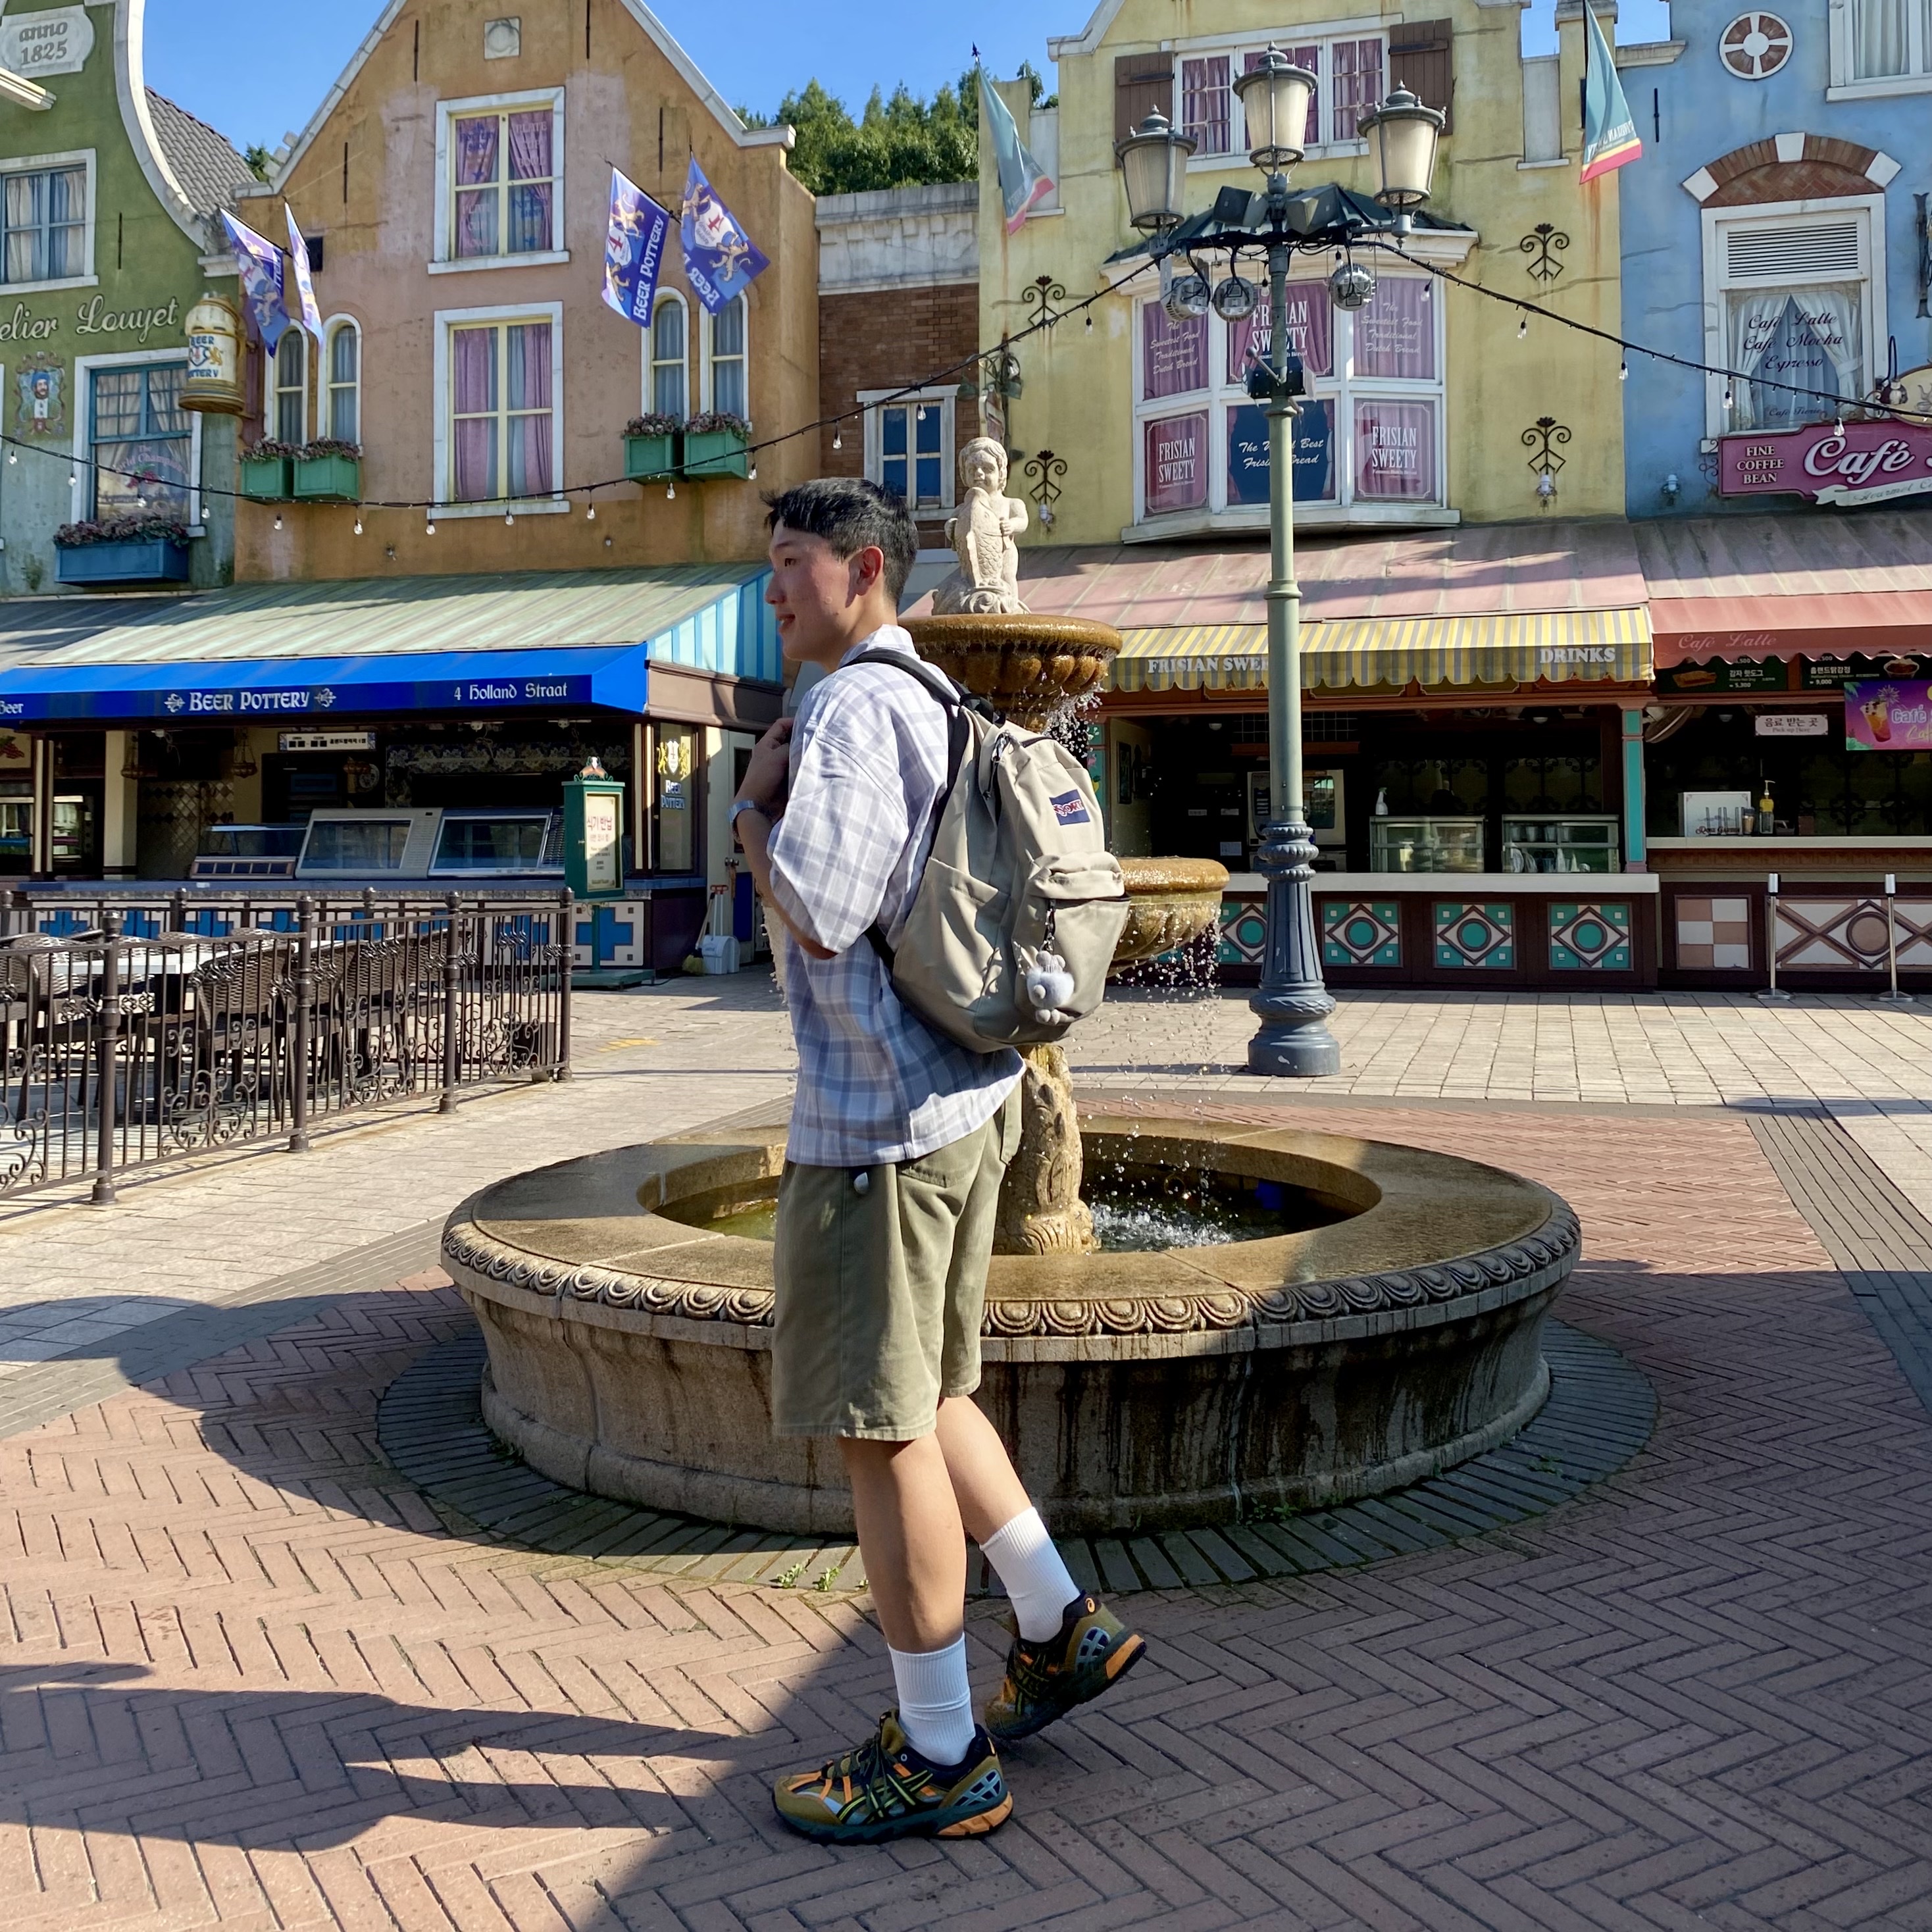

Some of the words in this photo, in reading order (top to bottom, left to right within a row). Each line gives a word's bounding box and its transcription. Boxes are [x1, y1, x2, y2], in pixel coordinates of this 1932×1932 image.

[19, 22, 68, 42] anno
[20, 38, 68, 65] 1825
[608, 236, 623, 253] 4
[640, 215, 664, 278] POTTERY
[634, 280, 651, 321] BEER
[1383, 303, 1399, 311] The
[76, 294, 180, 343] Louyet
[1361, 316, 1398, 325] Sweetest
[1402, 317, 1423, 327] Food
[1182, 330, 1200, 342] Food
[1369, 330, 1417, 340] Traditional
[1787, 333, 1843, 347] Mocha
[1156, 344, 1195, 360] Traditional
[1365, 343, 1391, 352] Dutch
[1395, 344, 1421, 353] Bread
[1153, 362, 1173, 374] Dutch
[1177, 357, 1198, 369] Bread
[1765, 355, 1823, 372] Espresso
[1372, 426, 1417, 447] FRISIAN
[1159, 438, 1196, 462] FRISIAN
[1238, 442, 1258, 453] The
[1300, 438, 1324, 448] Best
[1746, 445, 1775, 457] FINE
[1372, 448, 1417, 469] SWEETY
[1736, 459, 1785, 471] COFFEE
[1804, 436, 1916, 485] Café
[1159, 459, 1196, 482] SWEETY
[1743, 472, 1777, 484] BEAN
[1540, 648, 1616, 664] DRINKS
[1148, 658, 1219, 673] FRISIAN
[453, 686, 461, 700] 4
[469, 684, 517, 700] Holland
[525, 682, 567, 698] Straat
[240, 691, 309, 710] POTTERY
[1765, 717, 1783, 727] 음료
[1787, 717, 1806, 727] 받는
[1809, 717, 1818, 727] 곳
[1892, 704, 1927, 724] Café
[587, 816, 599, 830] 식기
[600, 816, 612, 830] 반납
